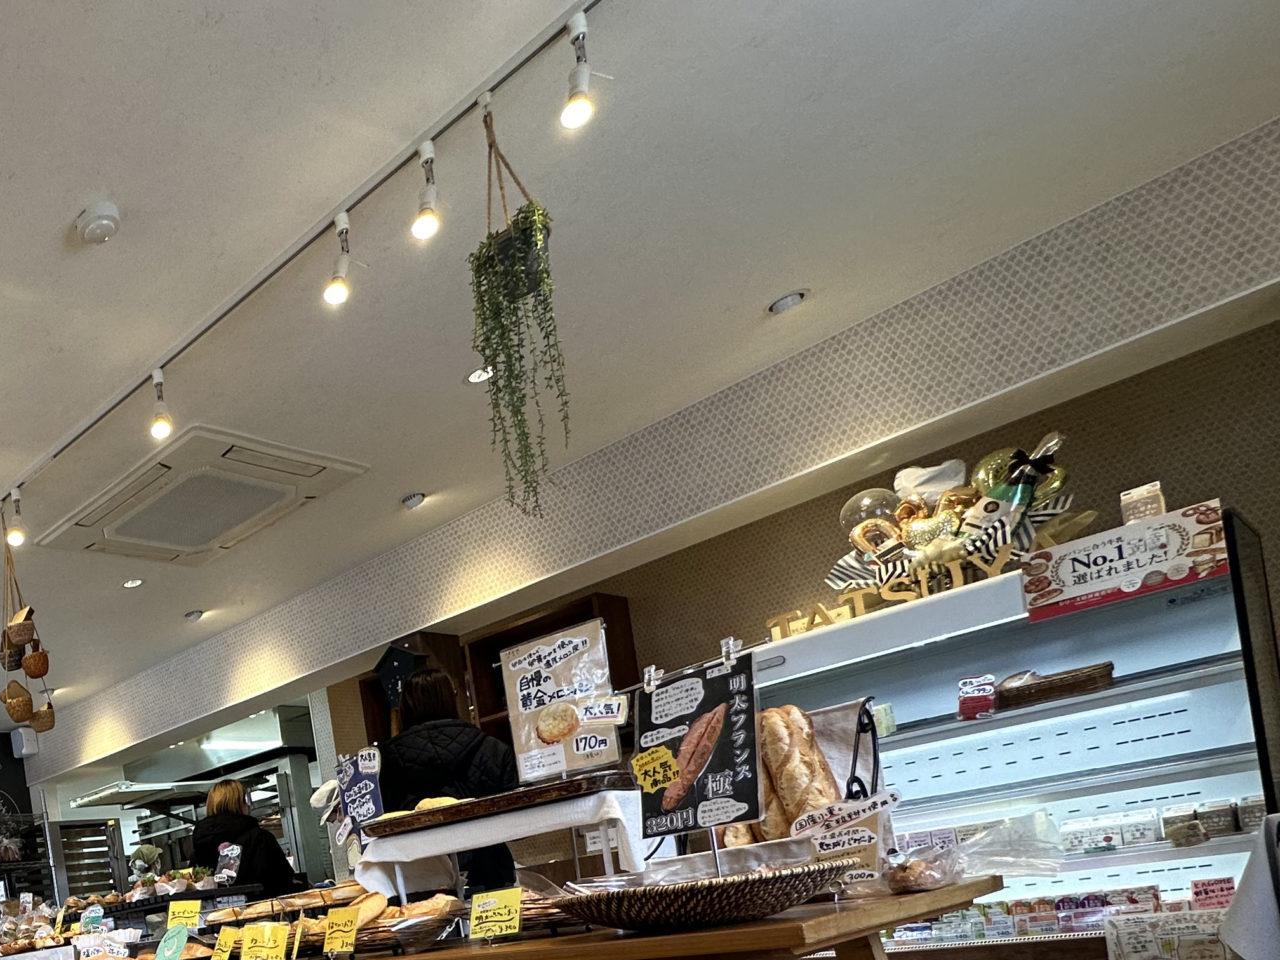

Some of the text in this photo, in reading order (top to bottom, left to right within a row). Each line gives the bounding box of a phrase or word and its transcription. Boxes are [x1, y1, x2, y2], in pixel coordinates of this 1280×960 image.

[1070, 543, 1127, 573] No.1
[519, 669, 552, 692] 自慢の
[729, 673, 752, 782] 明太フランス
[575, 735, 608, 752] 170円
[640, 760, 673, 782] 大人気
[704, 769, 734, 800] 極
[645, 807, 695, 835] 320円
